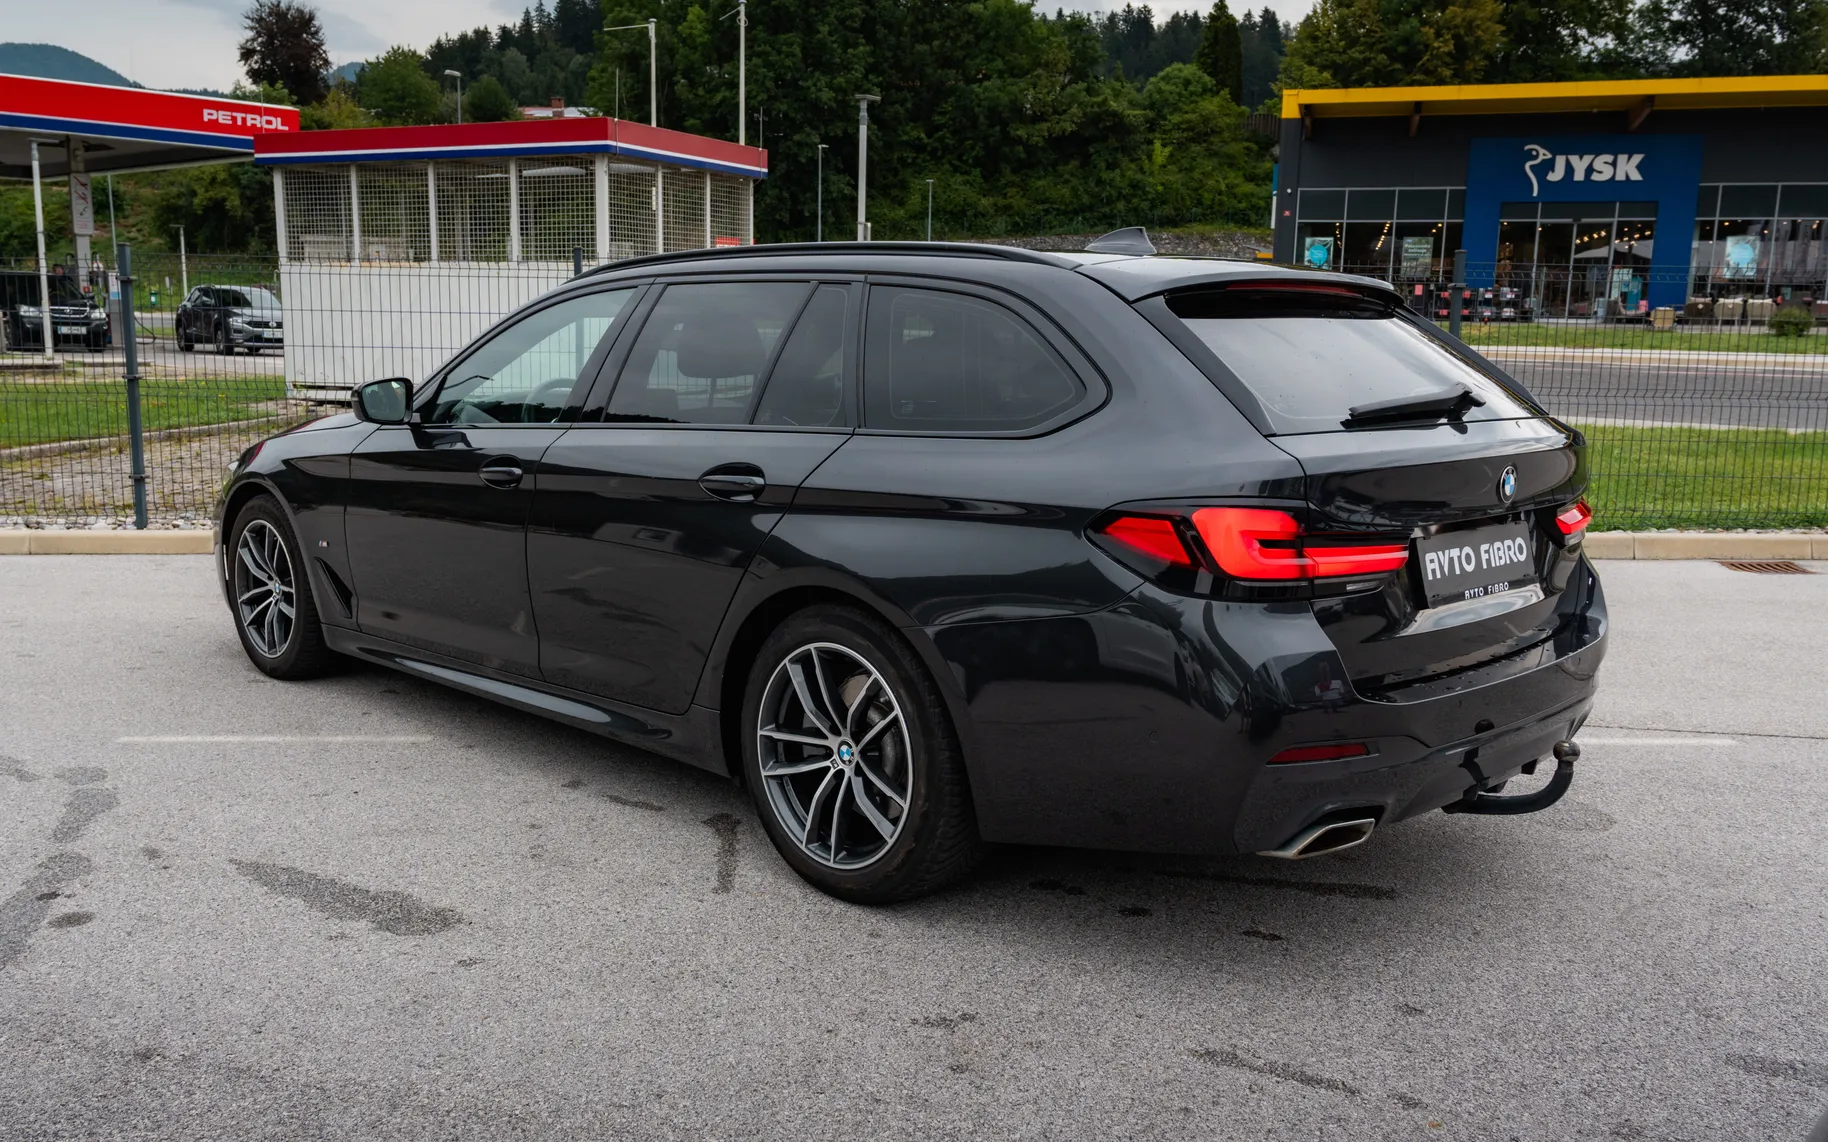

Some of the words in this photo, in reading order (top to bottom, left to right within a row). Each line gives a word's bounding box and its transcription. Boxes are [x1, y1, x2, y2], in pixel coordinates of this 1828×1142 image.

[203, 108, 289, 131] PETROL
[1546, 154, 1645, 182] JYSK
[1480, 537, 1527, 569] FIBRO
[1488, 582, 1509, 594] FIBRO
